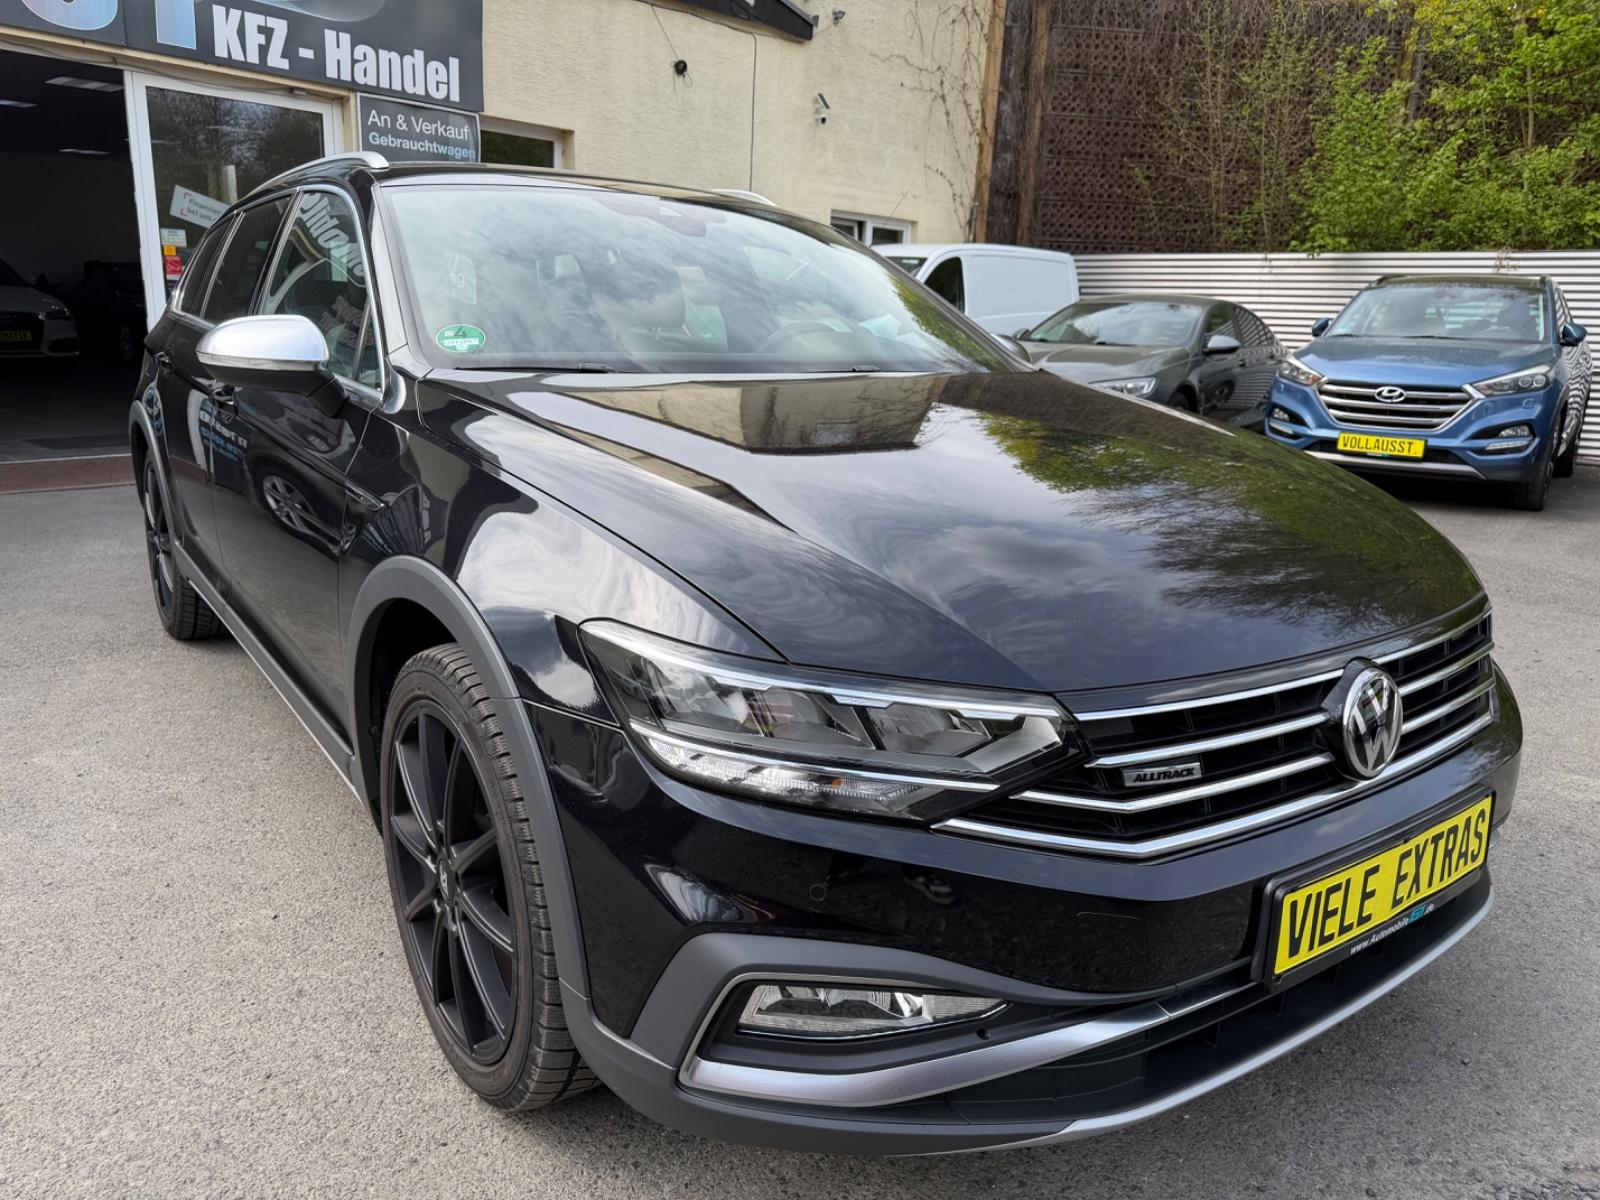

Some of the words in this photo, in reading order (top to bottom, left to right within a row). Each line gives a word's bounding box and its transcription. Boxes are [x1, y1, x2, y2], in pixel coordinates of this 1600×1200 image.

[212, 4, 290, 71] KFZ
[324, 28, 461, 103] Handel
[367, 109, 391, 129] An
[396, 113, 409, 131] &
[411, 115, 471, 141] Verkauf
[368, 131, 476, 160] Gebrauchtwagen
[1133, 767, 1195, 783] ALLTRACK
[1288, 864, 1380, 960] VIELE
[1391, 808, 1487, 910] EXTRAS
